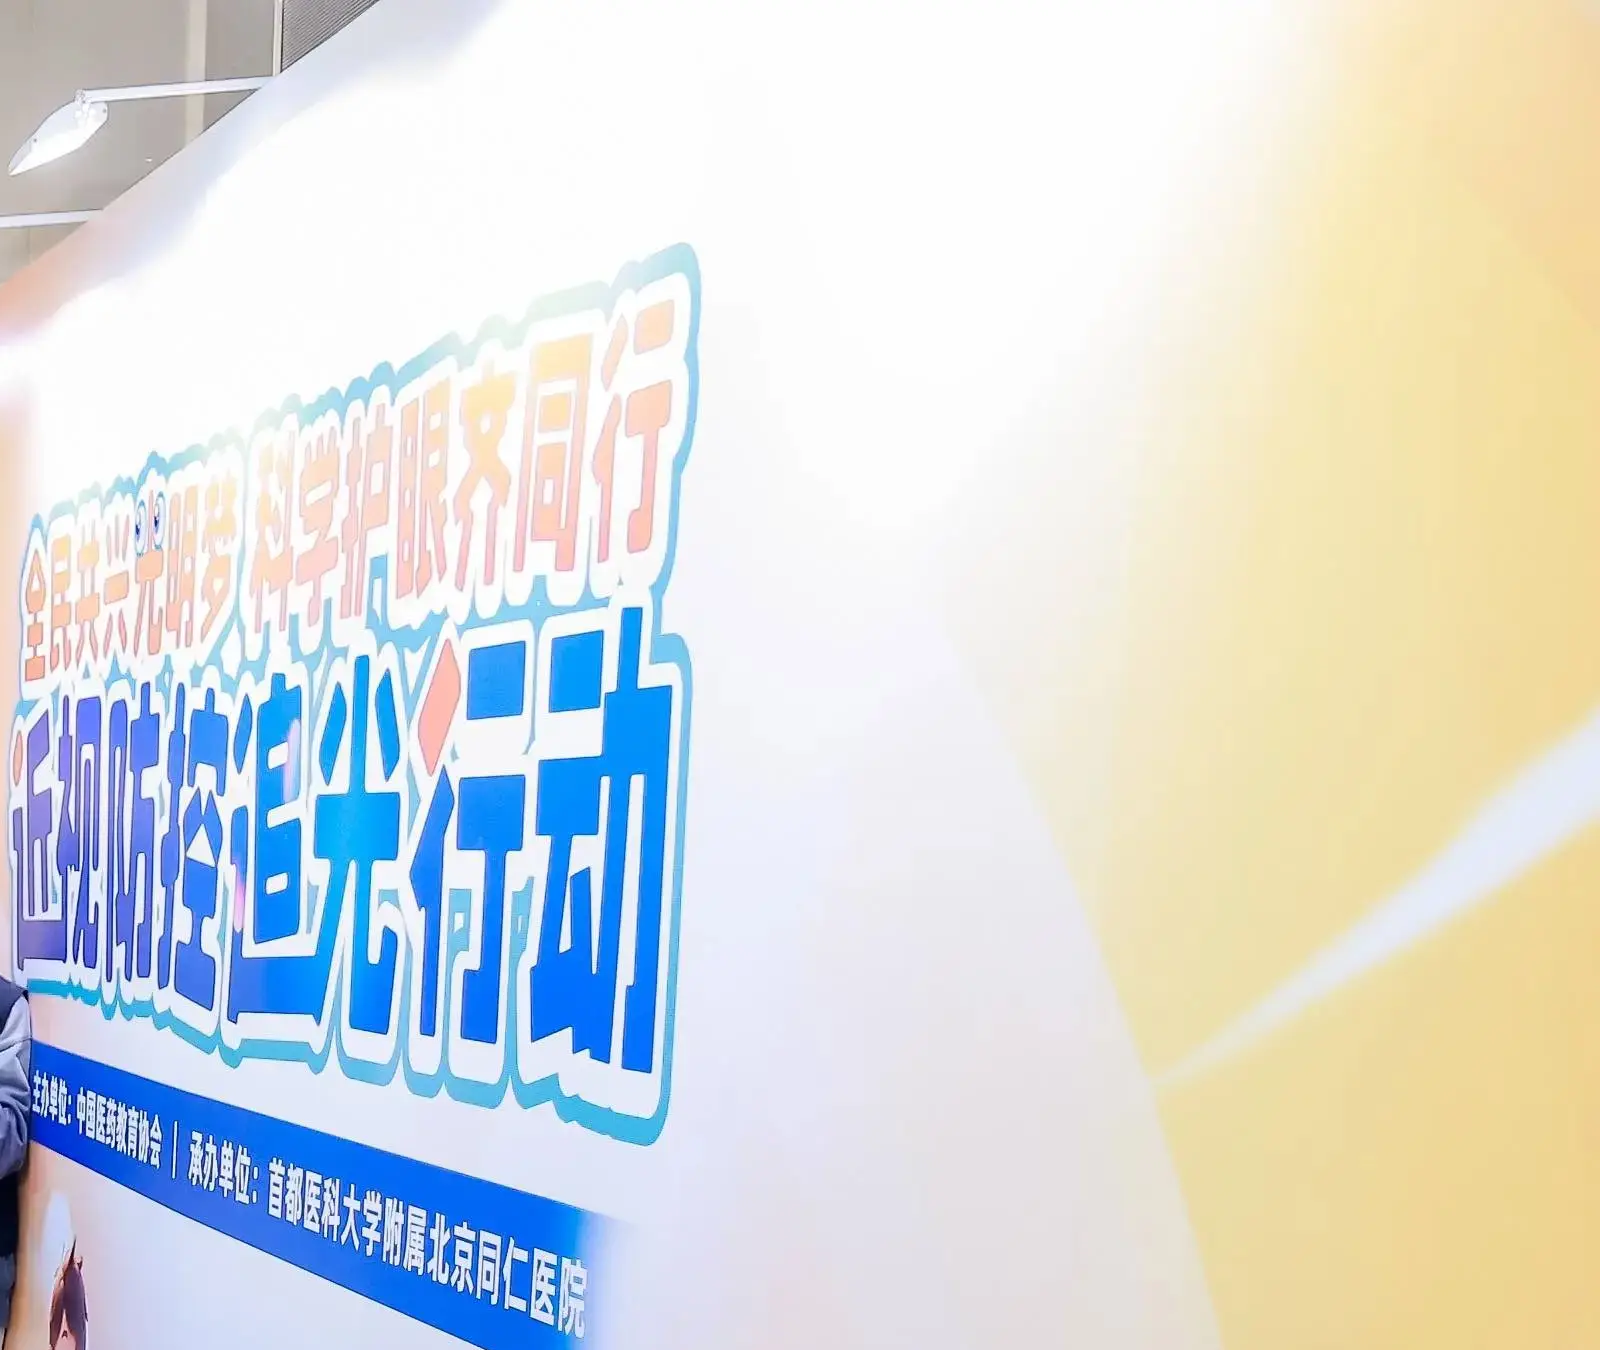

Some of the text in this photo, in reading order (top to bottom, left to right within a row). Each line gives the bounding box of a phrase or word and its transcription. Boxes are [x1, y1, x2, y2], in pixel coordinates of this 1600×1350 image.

[23, 299, 676, 682] 全民共兴光明梦 科学护眼齐同行
[11, 606, 672, 1073] 近视防控追光行动
[33, 1069, 589, 1340] 主办单位：中国医药教育协会 承办单位：首都医科大学附属北京同仁医院
